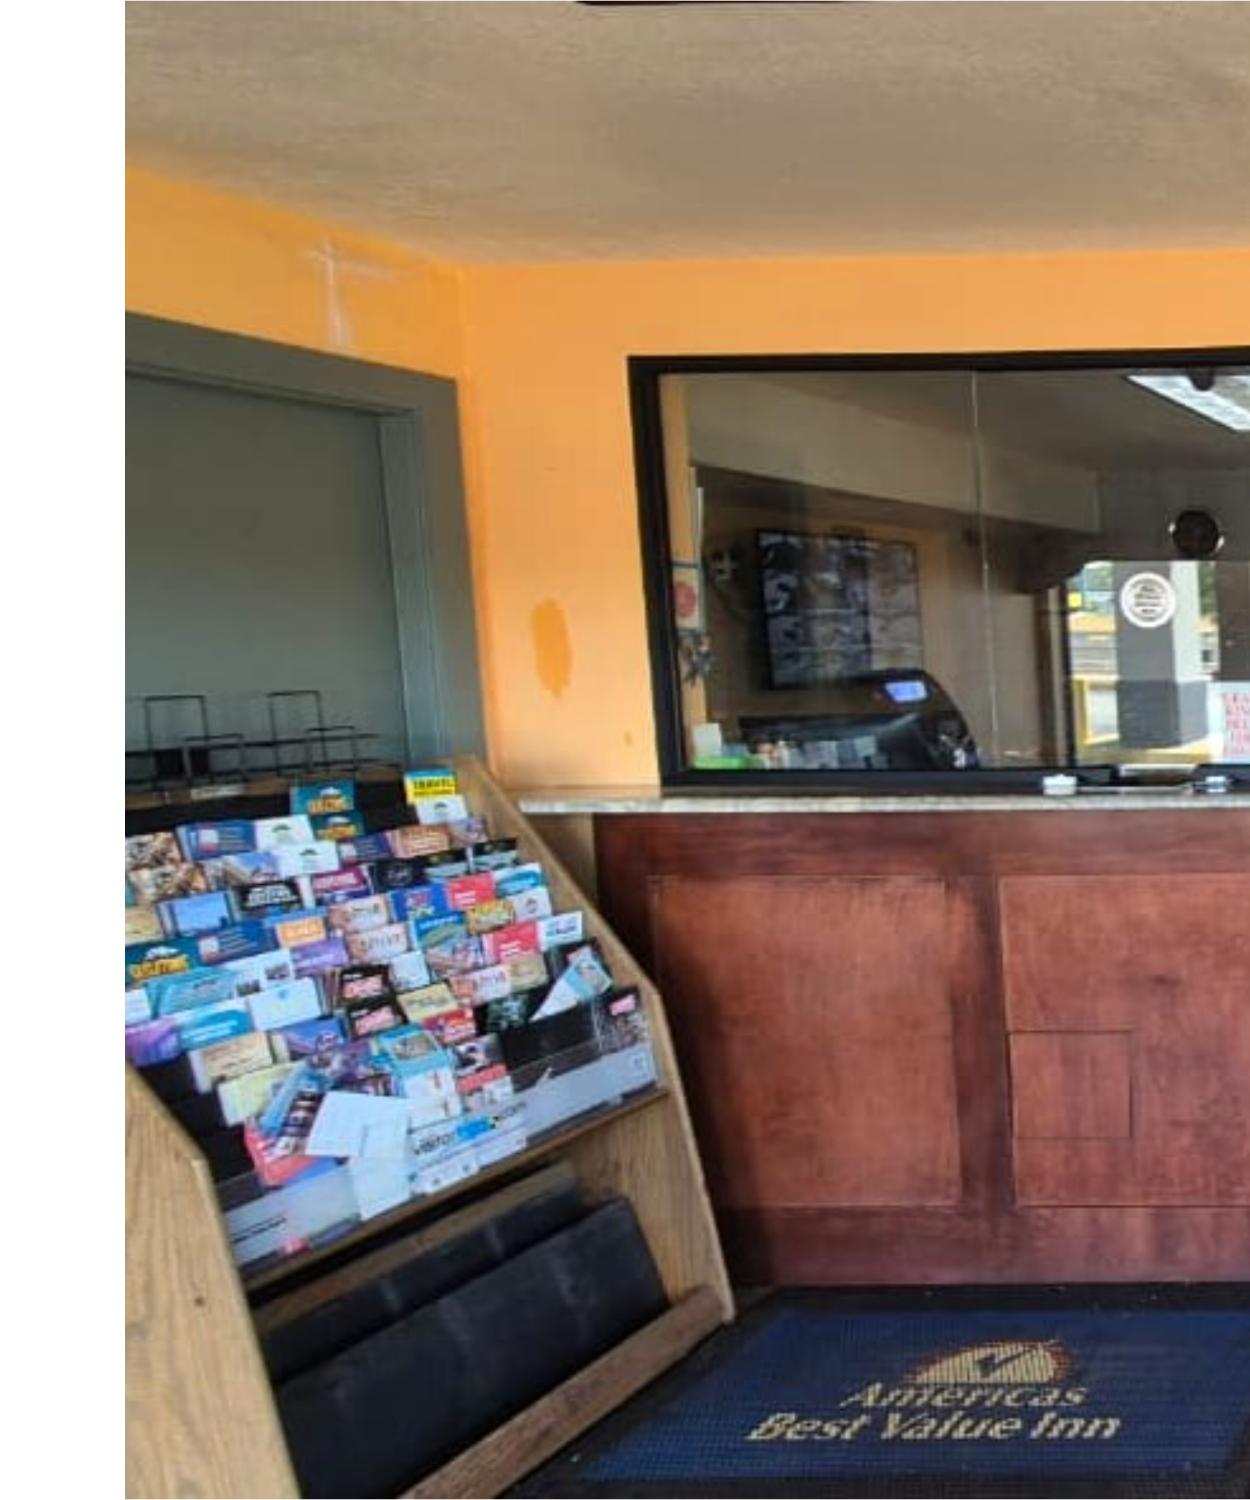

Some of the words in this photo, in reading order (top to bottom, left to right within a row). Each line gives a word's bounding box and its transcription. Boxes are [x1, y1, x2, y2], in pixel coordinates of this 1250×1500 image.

[839, 1382, 1088, 1408] Americas
[745, 1412, 871, 1441] Best
[879, 1410, 1024, 1441] Value
[1029, 1411, 1121, 1440] Inn
